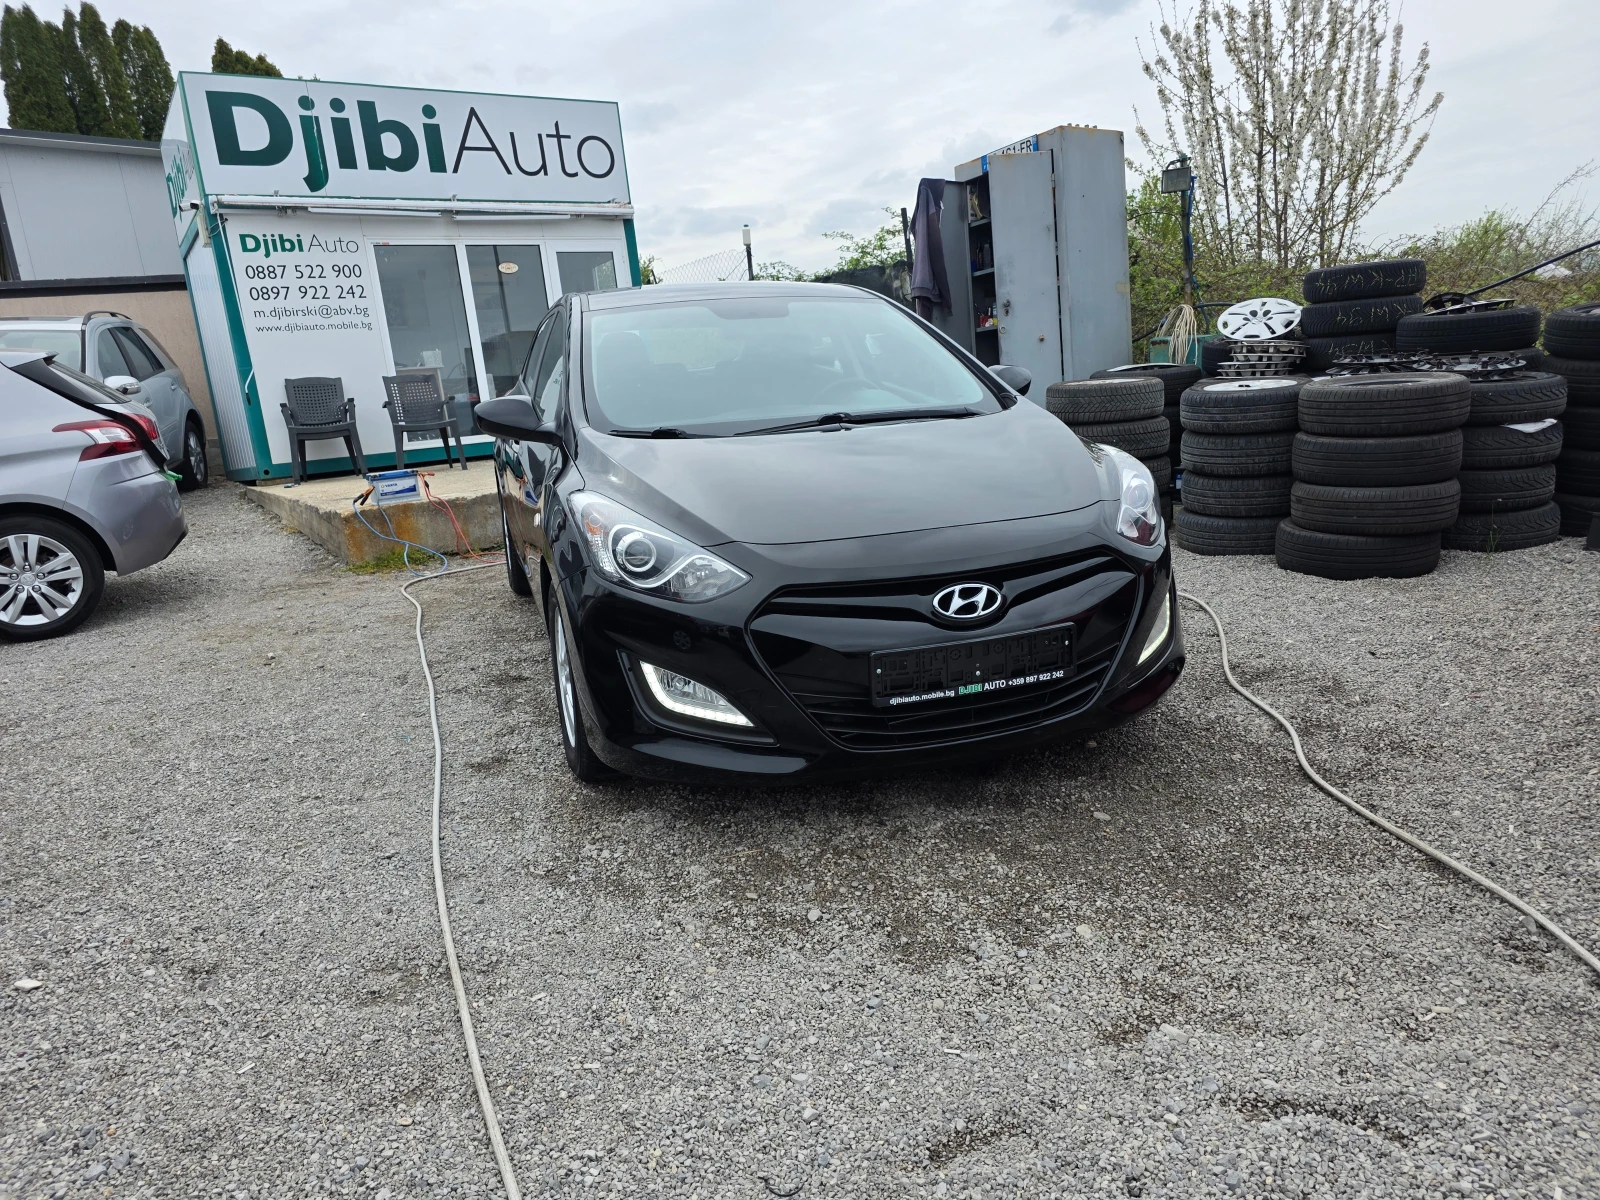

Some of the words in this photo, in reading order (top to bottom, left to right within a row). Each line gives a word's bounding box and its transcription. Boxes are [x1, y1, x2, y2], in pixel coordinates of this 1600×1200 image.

[239, 234, 304, 258] Djibi
[308, 234, 359, 253] Auto
[245, 265, 286, 280] 0887
[294, 264, 327, 279] 522
[331, 264, 362, 278] 900
[249, 286, 290, 301] 0897
[298, 285, 330, 300] 922
[335, 284, 367, 299] 242
[253, 304, 370, 320] m.djibirski@abv.bg
[255, 321, 373, 333] www.djibiauto.mobile.bg
[889, 690, 954, 705] djibiauto.mobile.bg
[959, 684, 982, 694] DJIBI
[983, 680, 1006, 691] AUTO
[1008, 677, 1025, 687] +359
[1025, 675, 1038, 684] 897
[1039, 673, 1051, 682] 922
[1052, 670, 1064, 679] 242
